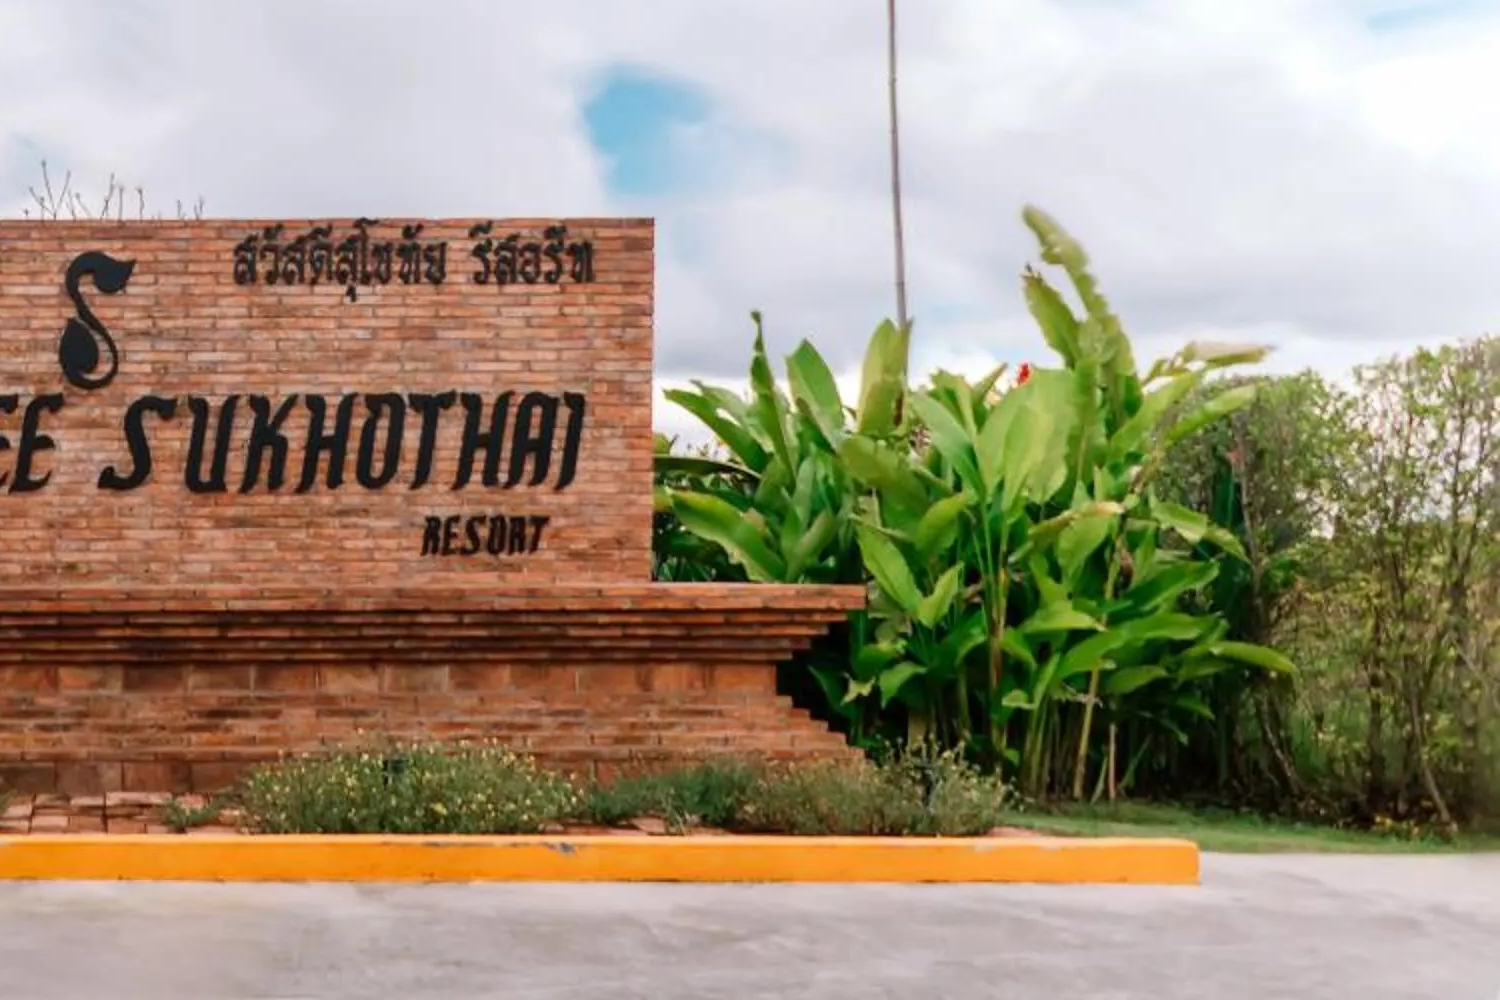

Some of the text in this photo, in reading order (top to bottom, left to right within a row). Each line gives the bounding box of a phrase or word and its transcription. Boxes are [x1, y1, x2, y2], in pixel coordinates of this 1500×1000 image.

[233, 218, 447, 302] สวัสดีสุโขทัย
[99, 391, 586, 494] SUKHOTHAI
[420, 514, 550, 556] RESORT
